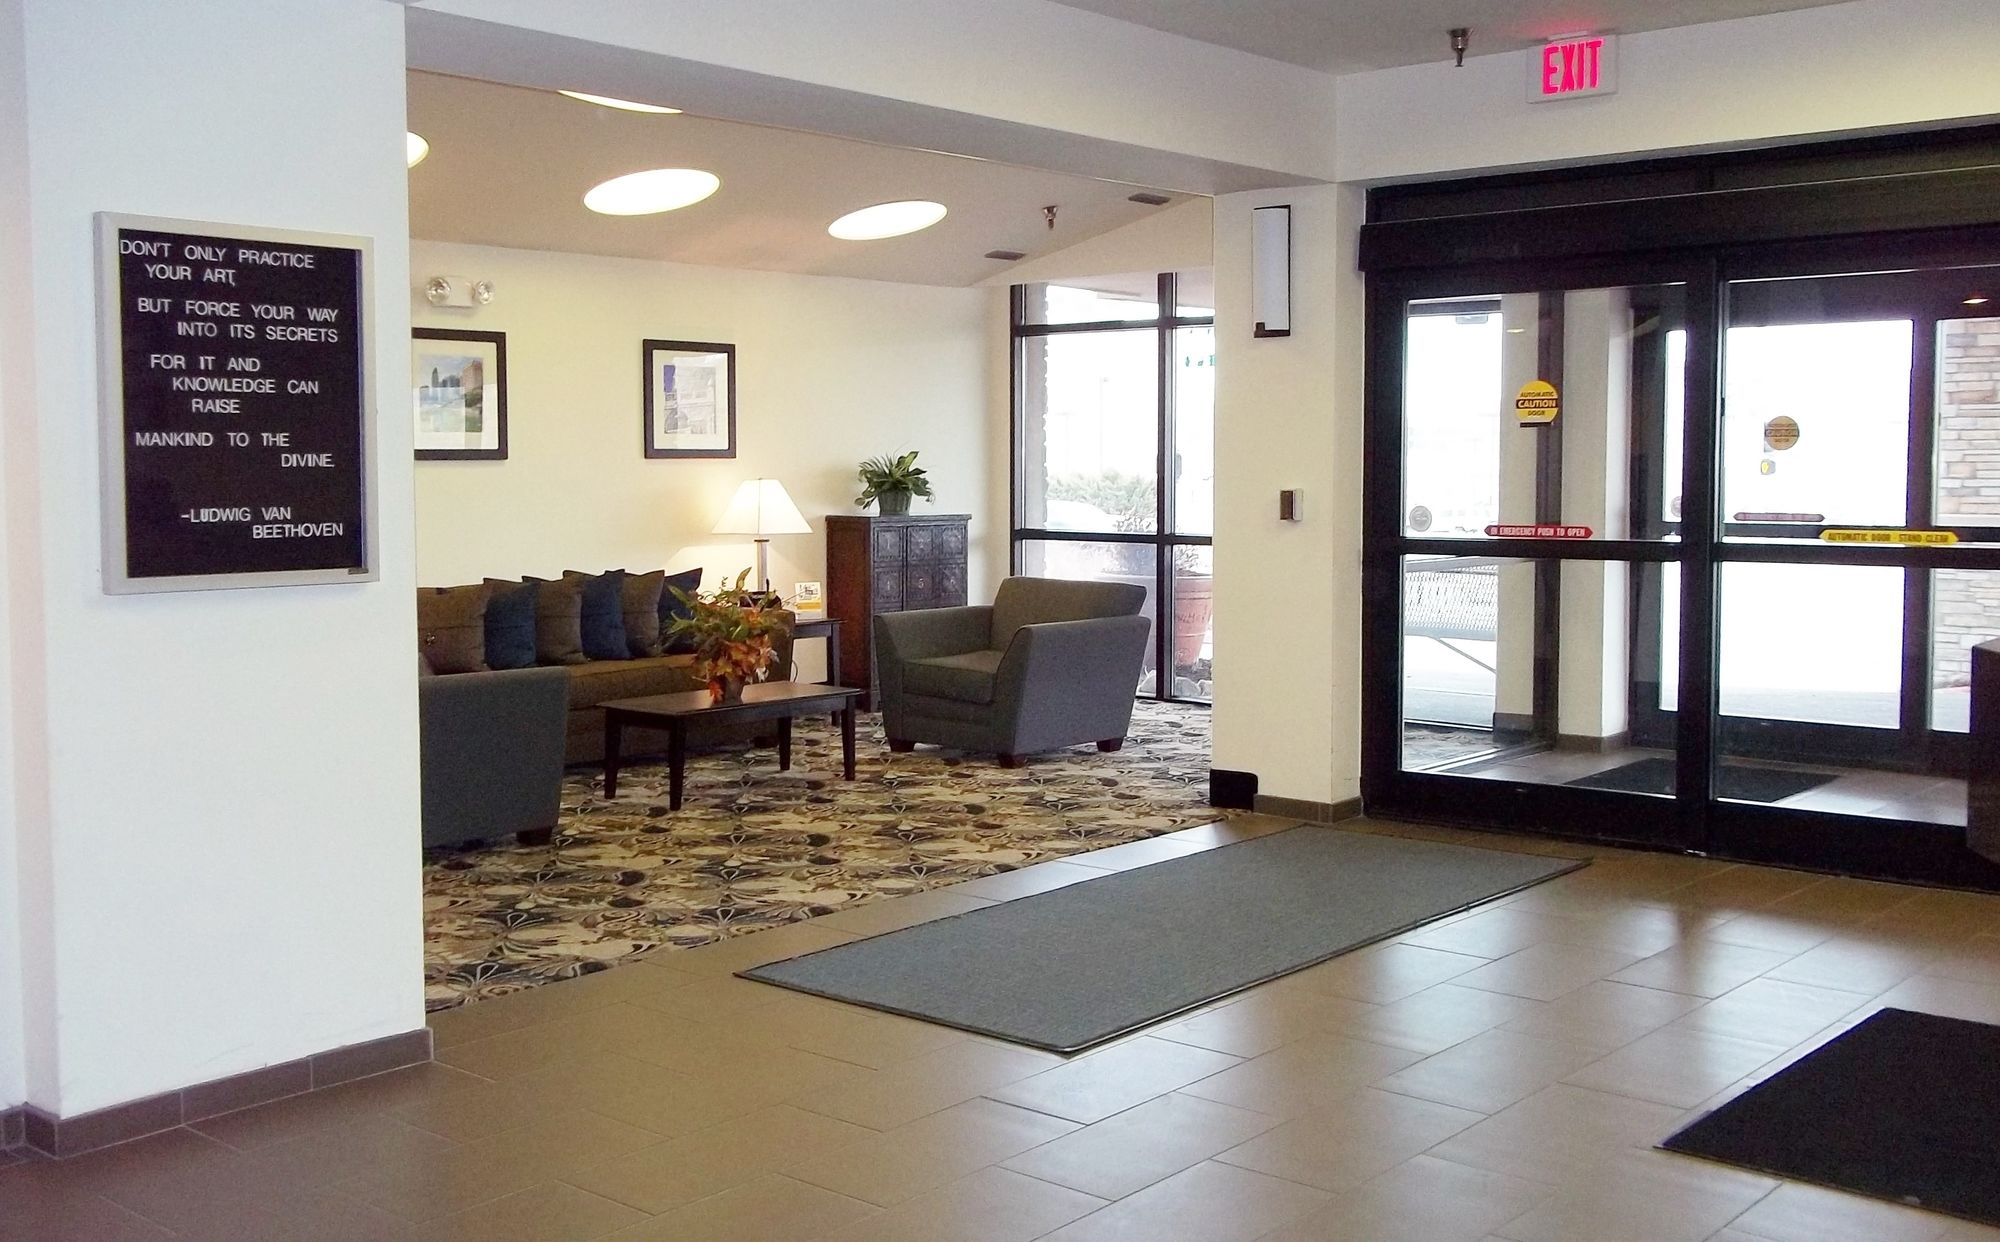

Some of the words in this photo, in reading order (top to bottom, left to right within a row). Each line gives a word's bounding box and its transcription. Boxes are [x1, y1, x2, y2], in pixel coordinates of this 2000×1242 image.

[1543, 39, 1603, 95] EXIT
[120, 239, 172, 258] DON'T
[184, 245, 227, 262] ONLY
[238, 249, 315, 269] PRACTICE
[145, 263, 192, 281] YOUR
[203, 268, 236, 287] ART,
[138, 297, 172, 314] BUT
[185, 300, 241, 317] FORCE
[251, 304, 295, 320] YOUR
[307, 307, 339, 322] WAY
[177, 321, 218, 337] INTO
[230, 324, 256, 340] ITS
[265, 325, 339, 343] SECRETS
[150, 354, 186, 370] FOR
[199, 356, 216, 371] IT
[227, 357, 261, 372] AND
[172, 377, 276, 394] KNOWLEDGE
[287, 380, 320, 394] CAN
[191, 399, 241, 414] RAISE
[1518, 399, 1556, 408] CAUTION
[135, 432, 214, 447] MANKIND
[227, 432, 250, 447] TO
[261, 433, 290, 447] THE
[262, 506, 292, 521] VAN
[252, 523, 344, 539] BEETHOVEN
[1499, 526, 1536, 536] EMERGENCY
[1537, 527, 1555, 536] PUSH
[1556, 527, 1565, 537] TO
[1567, 528, 1586, 537] OPEN
[1828, 532, 1868, 542] AUTOMATIC
[1898, 533, 1922, 543] STAND
